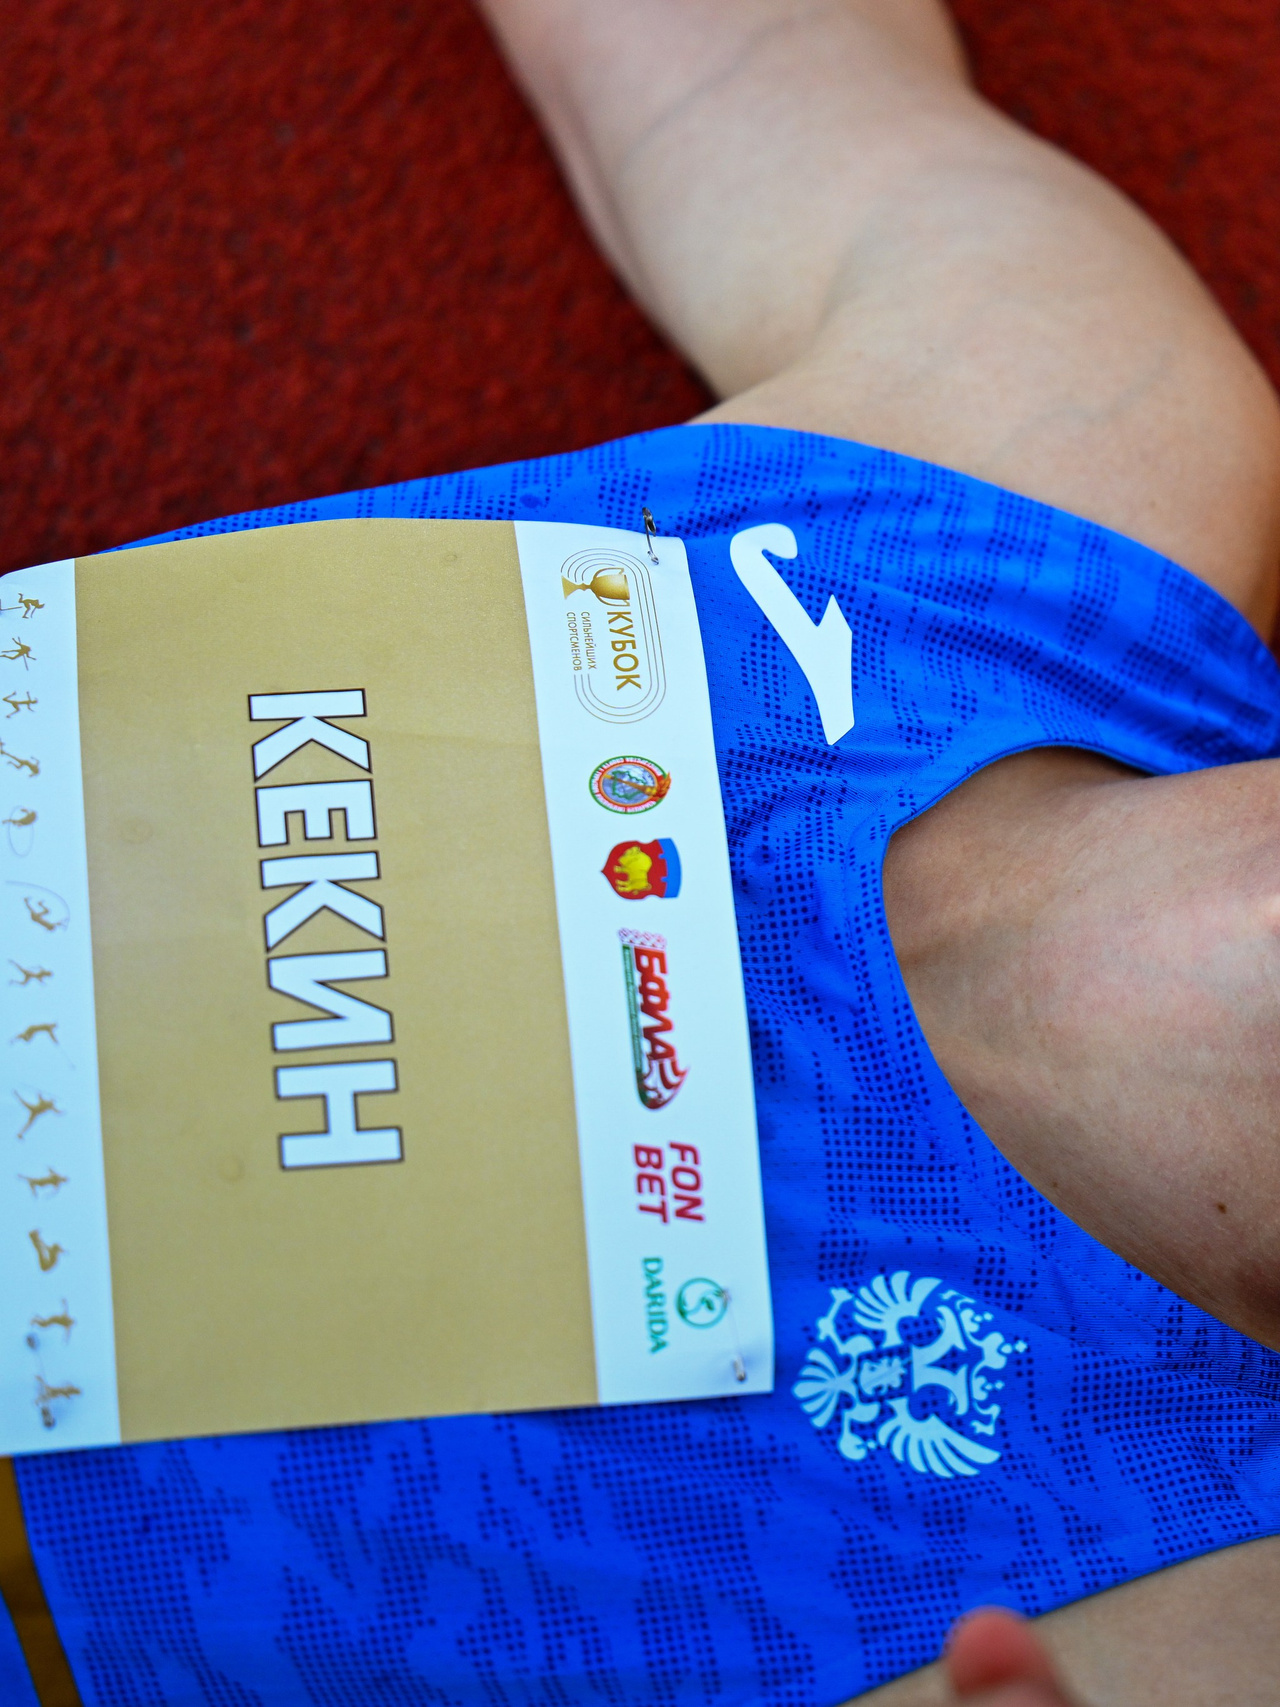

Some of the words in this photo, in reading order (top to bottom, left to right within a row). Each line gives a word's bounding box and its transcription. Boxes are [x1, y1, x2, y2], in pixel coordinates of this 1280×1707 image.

[566, 611, 582, 671] СПОРТСМЕНОВ
[581, 611, 598, 670] СИЛЬНЕЙШИХ
[606, 611, 642, 691] КУБОК
[248, 688, 405, 1171] КЕКИН
[633, 945, 676, 1061] БФЛА
[633, 1143, 669, 1224] BET
[669, 1141, 705, 1222] FON
[642, 1256, 669, 1355] DARIDA
